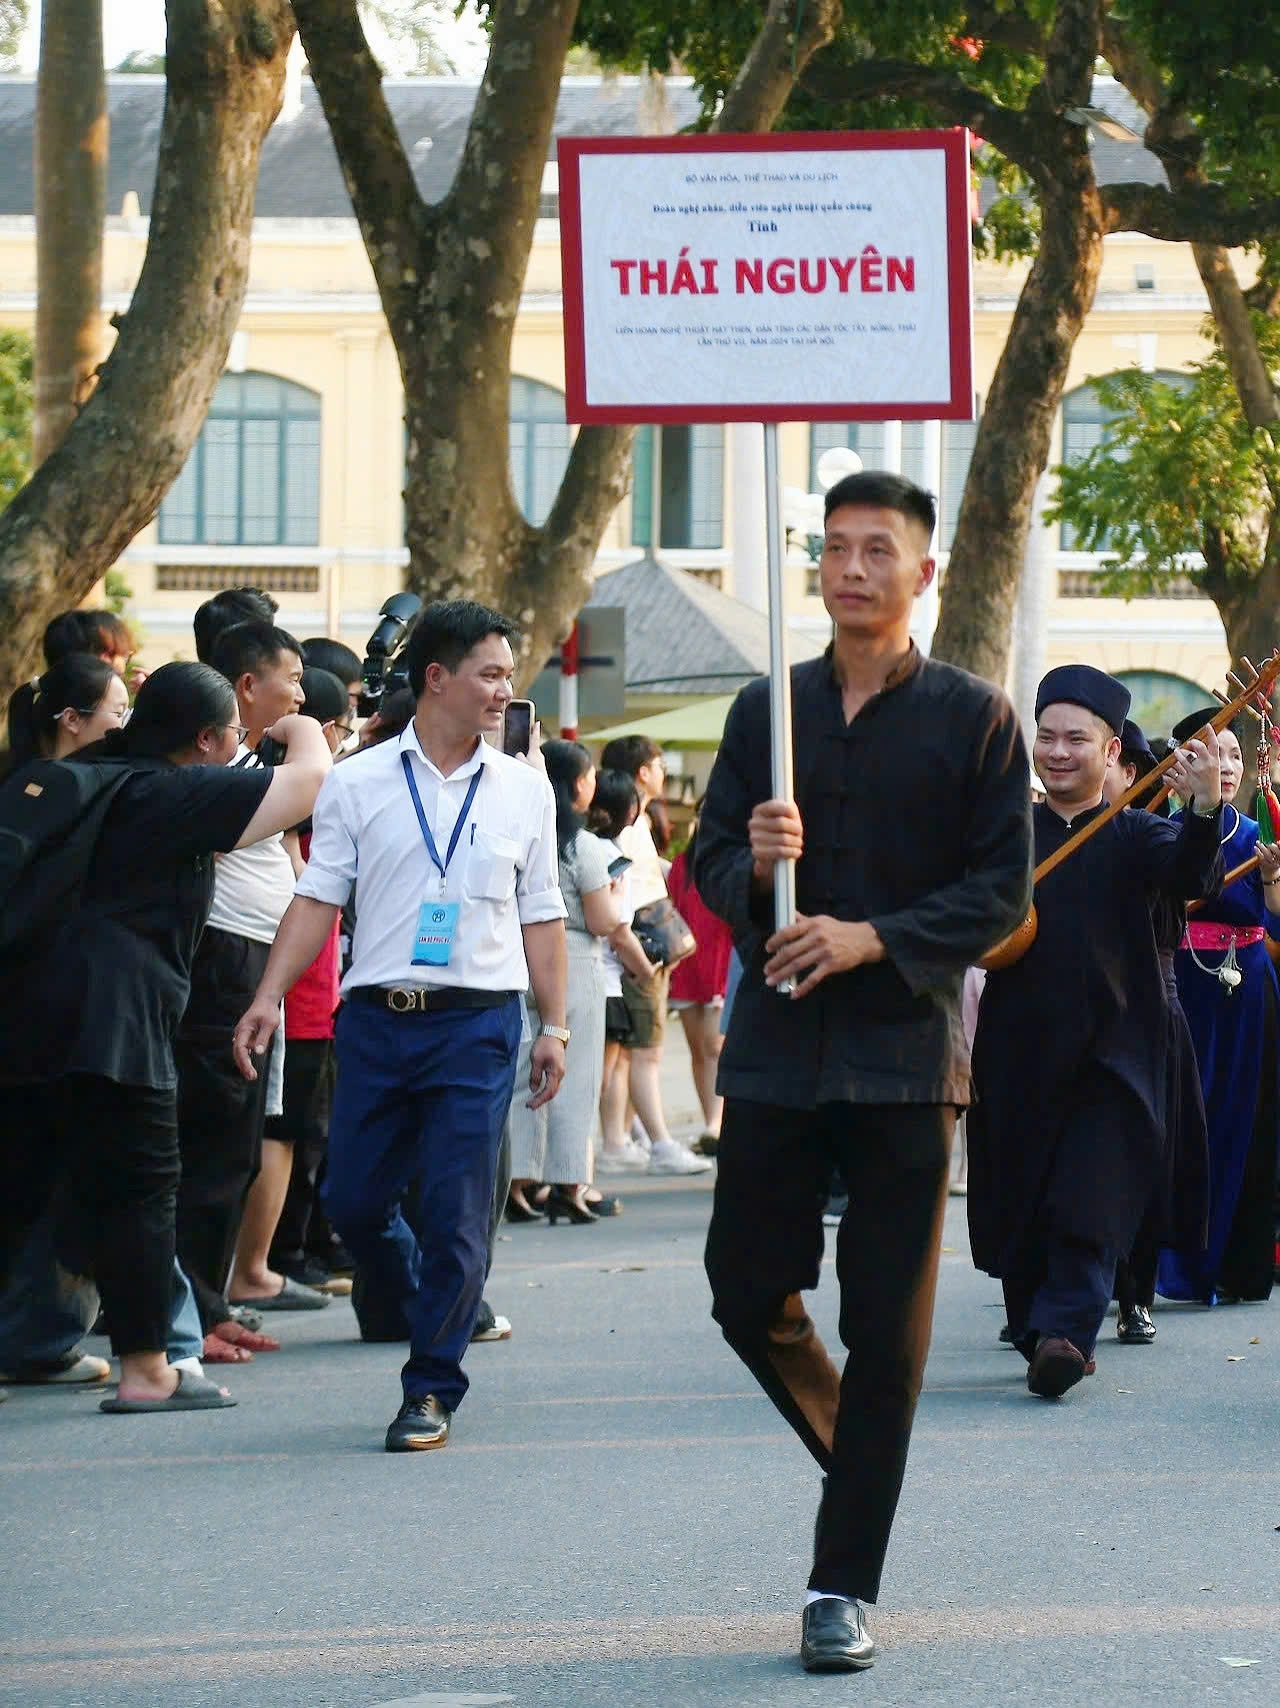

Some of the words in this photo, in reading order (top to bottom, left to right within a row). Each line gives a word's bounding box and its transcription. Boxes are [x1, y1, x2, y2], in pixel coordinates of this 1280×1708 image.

[685, 173, 698, 184] BỘ
[700, 173, 717, 182] VĂN
[763, 173, 787, 182] THAO
[789, 172, 801, 181] VÀ
[803, 173, 815, 181] DU
[818, 172, 839, 182] LỊCH
[610, 246, 719, 295] THÁI
[734, 244, 916, 295] NGUYÊN
